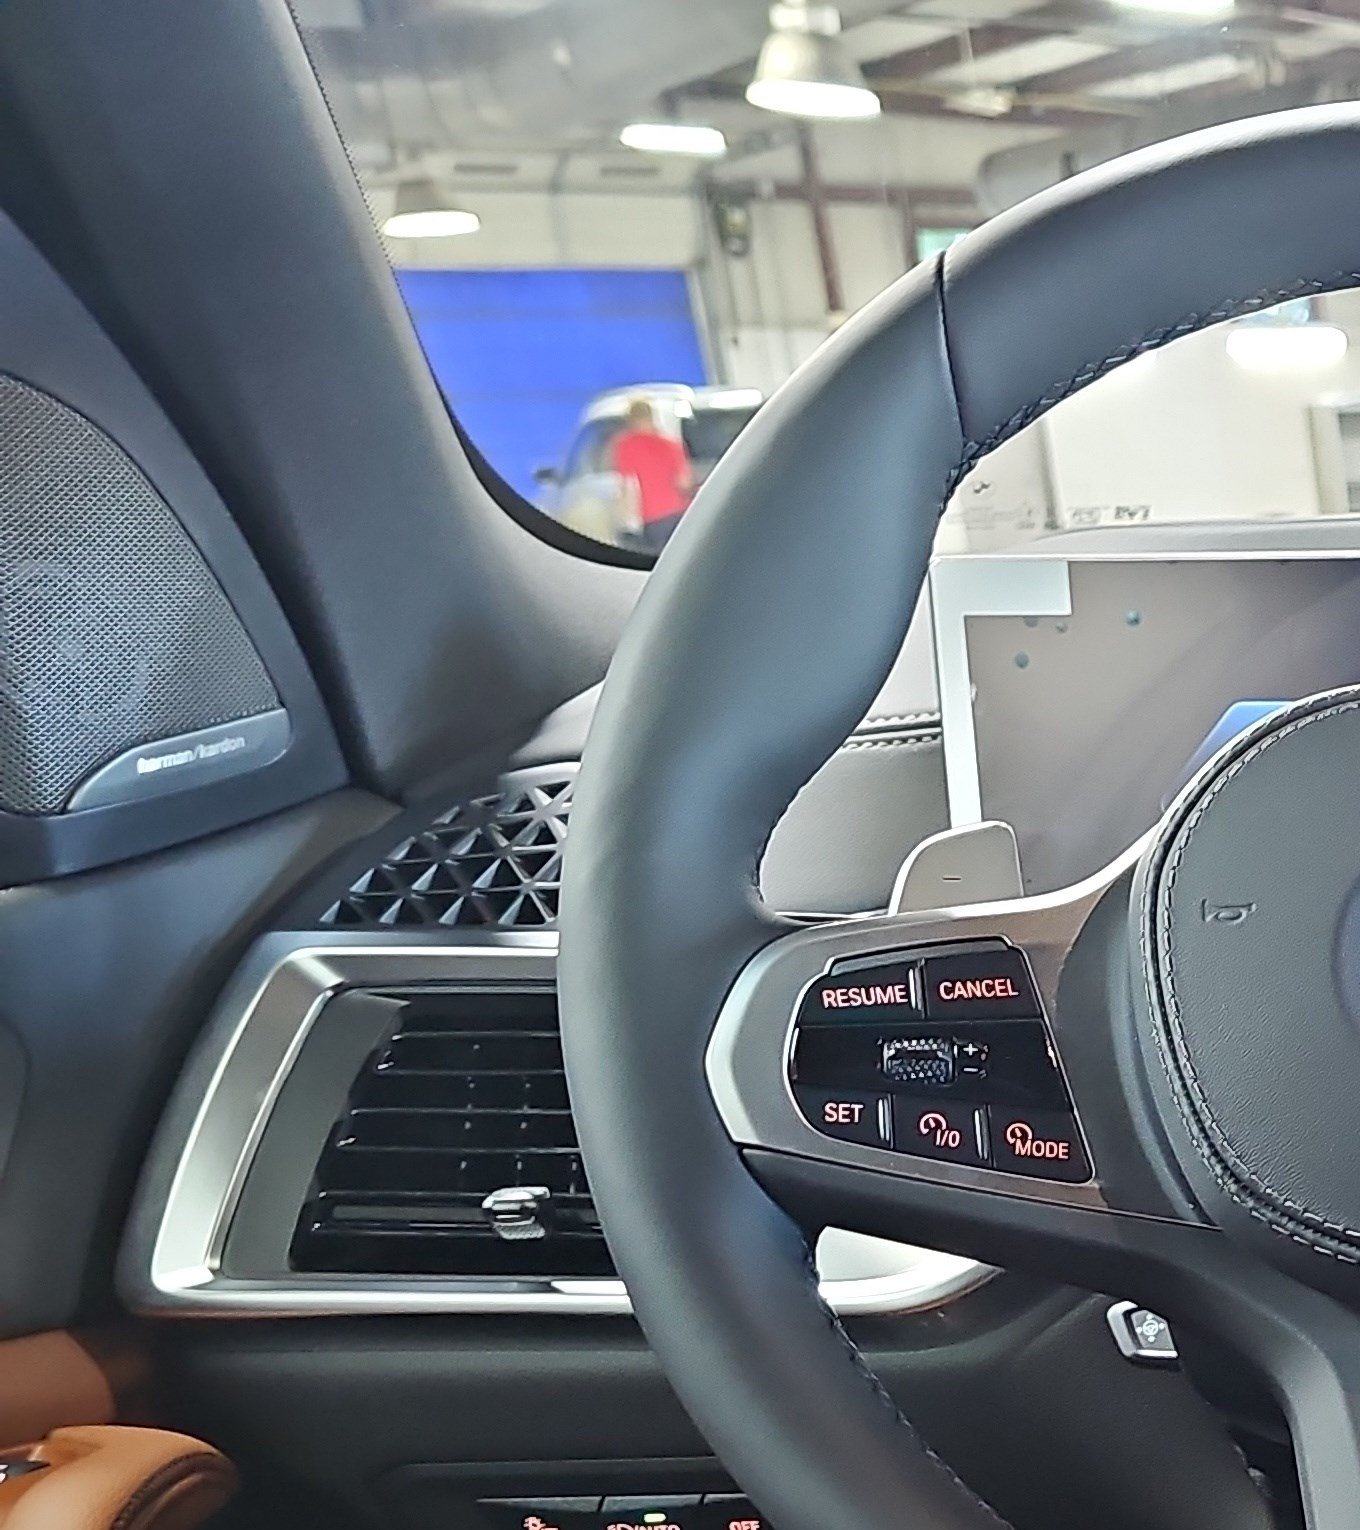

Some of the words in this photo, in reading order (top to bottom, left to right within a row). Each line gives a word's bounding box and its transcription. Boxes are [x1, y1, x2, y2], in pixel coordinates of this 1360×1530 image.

[822, 984, 907, 1009] RESUME
[939, 978, 1019, 1001] CANCEL
[823, 1102, 863, 1124] SET
[1014, 1137, 1070, 1160] MODE
